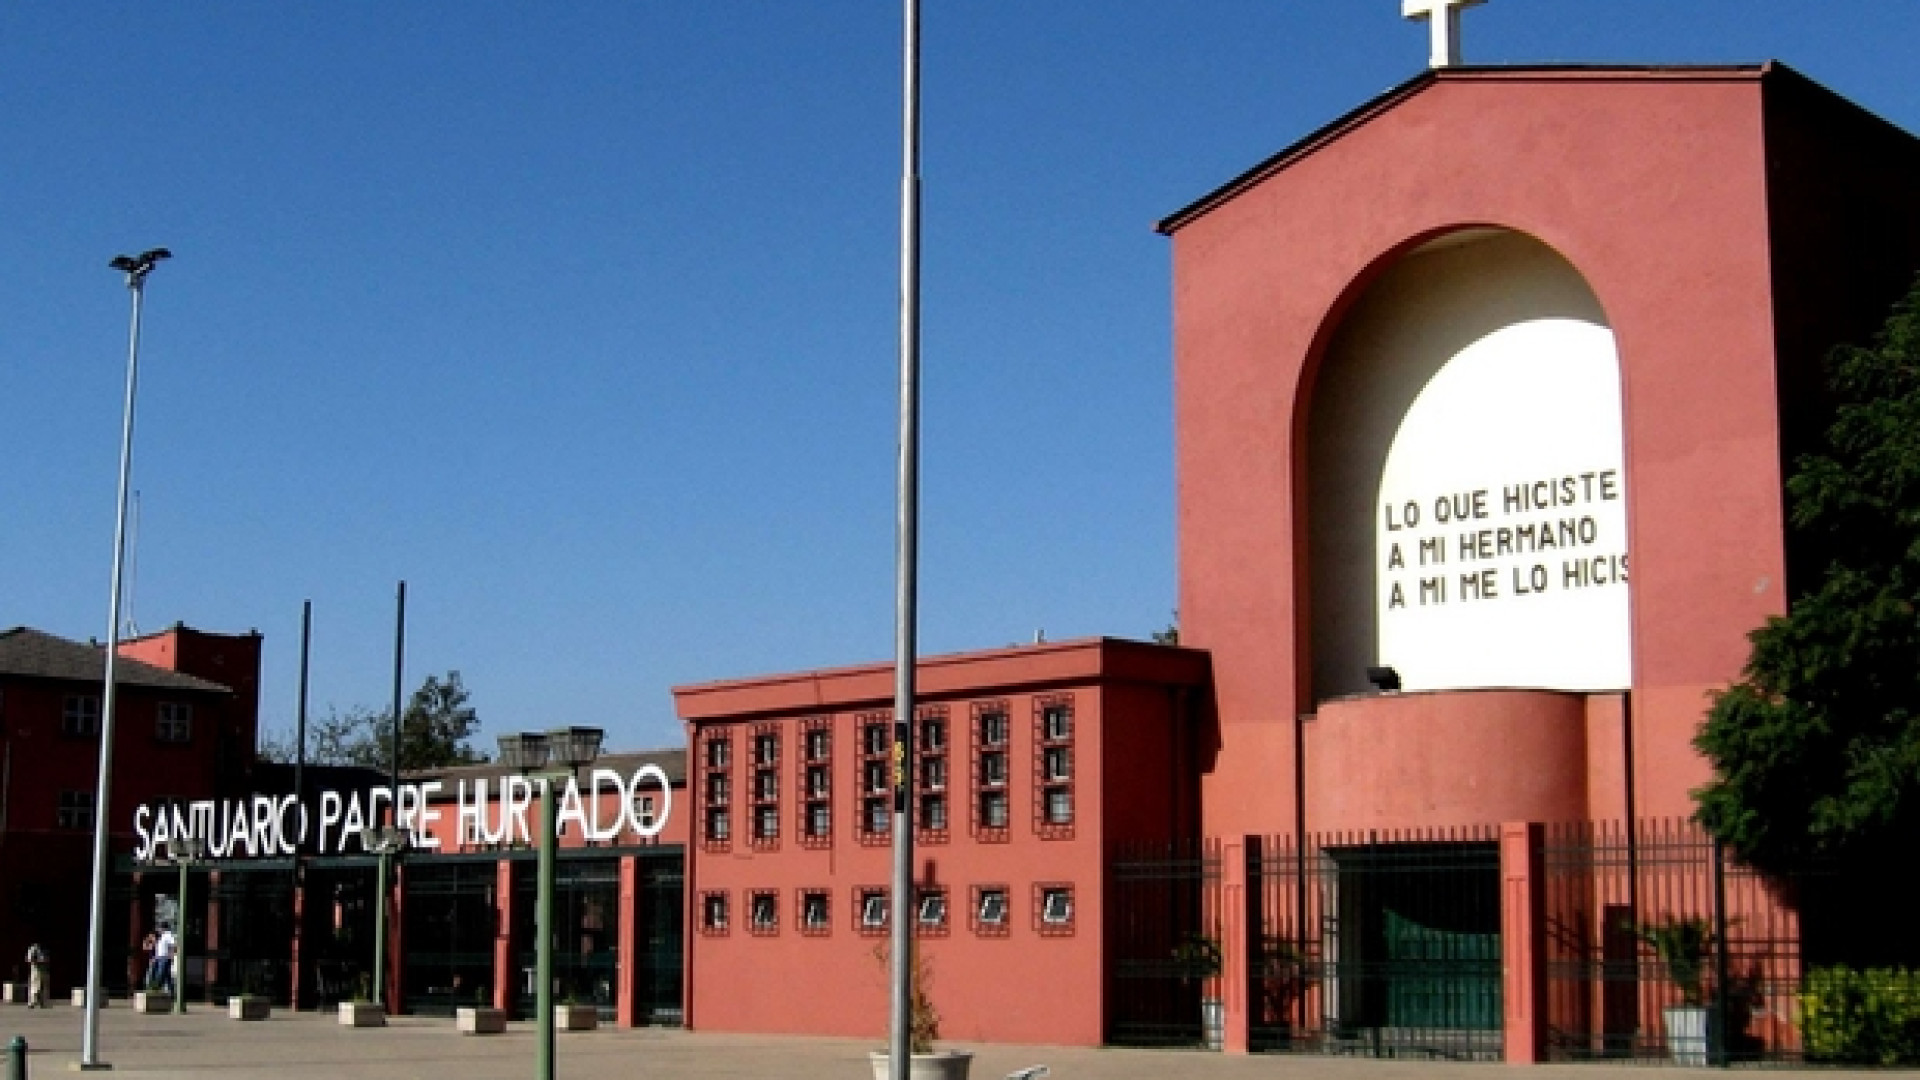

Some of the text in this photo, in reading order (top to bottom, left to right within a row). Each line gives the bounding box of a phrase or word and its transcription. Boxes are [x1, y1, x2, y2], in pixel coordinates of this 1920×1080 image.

[1385, 468, 1619, 531] LO QUE HICISTE
[1388, 515, 1597, 570] A MI HERMANO
[1388, 580, 1406, 610] A
[1420, 576, 1446, 606] MI
[1460, 568, 1498, 602] ME
[1512, 564, 1548, 596] LO
[134, 791, 309, 861] SANTUARIO
